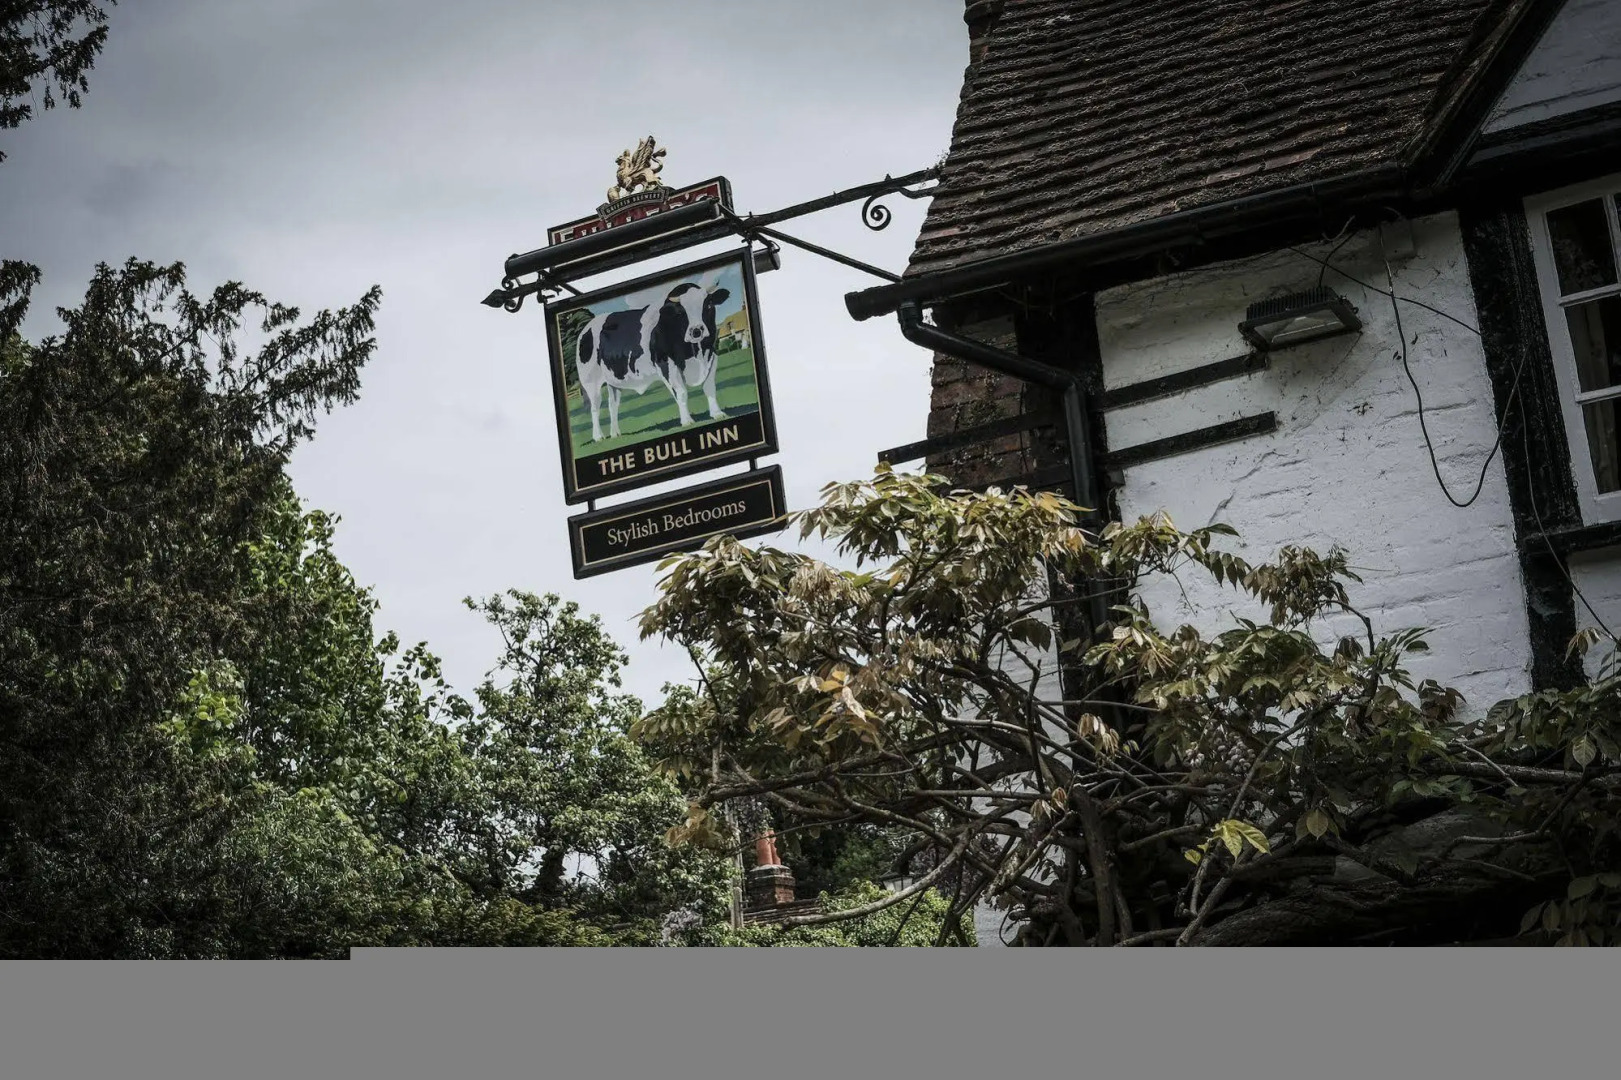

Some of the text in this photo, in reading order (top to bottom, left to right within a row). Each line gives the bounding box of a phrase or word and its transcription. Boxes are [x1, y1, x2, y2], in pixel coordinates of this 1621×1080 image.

[598, 425, 739, 475] THE BULL INN
[607, 500, 746, 547] Stylish Bedrooms
